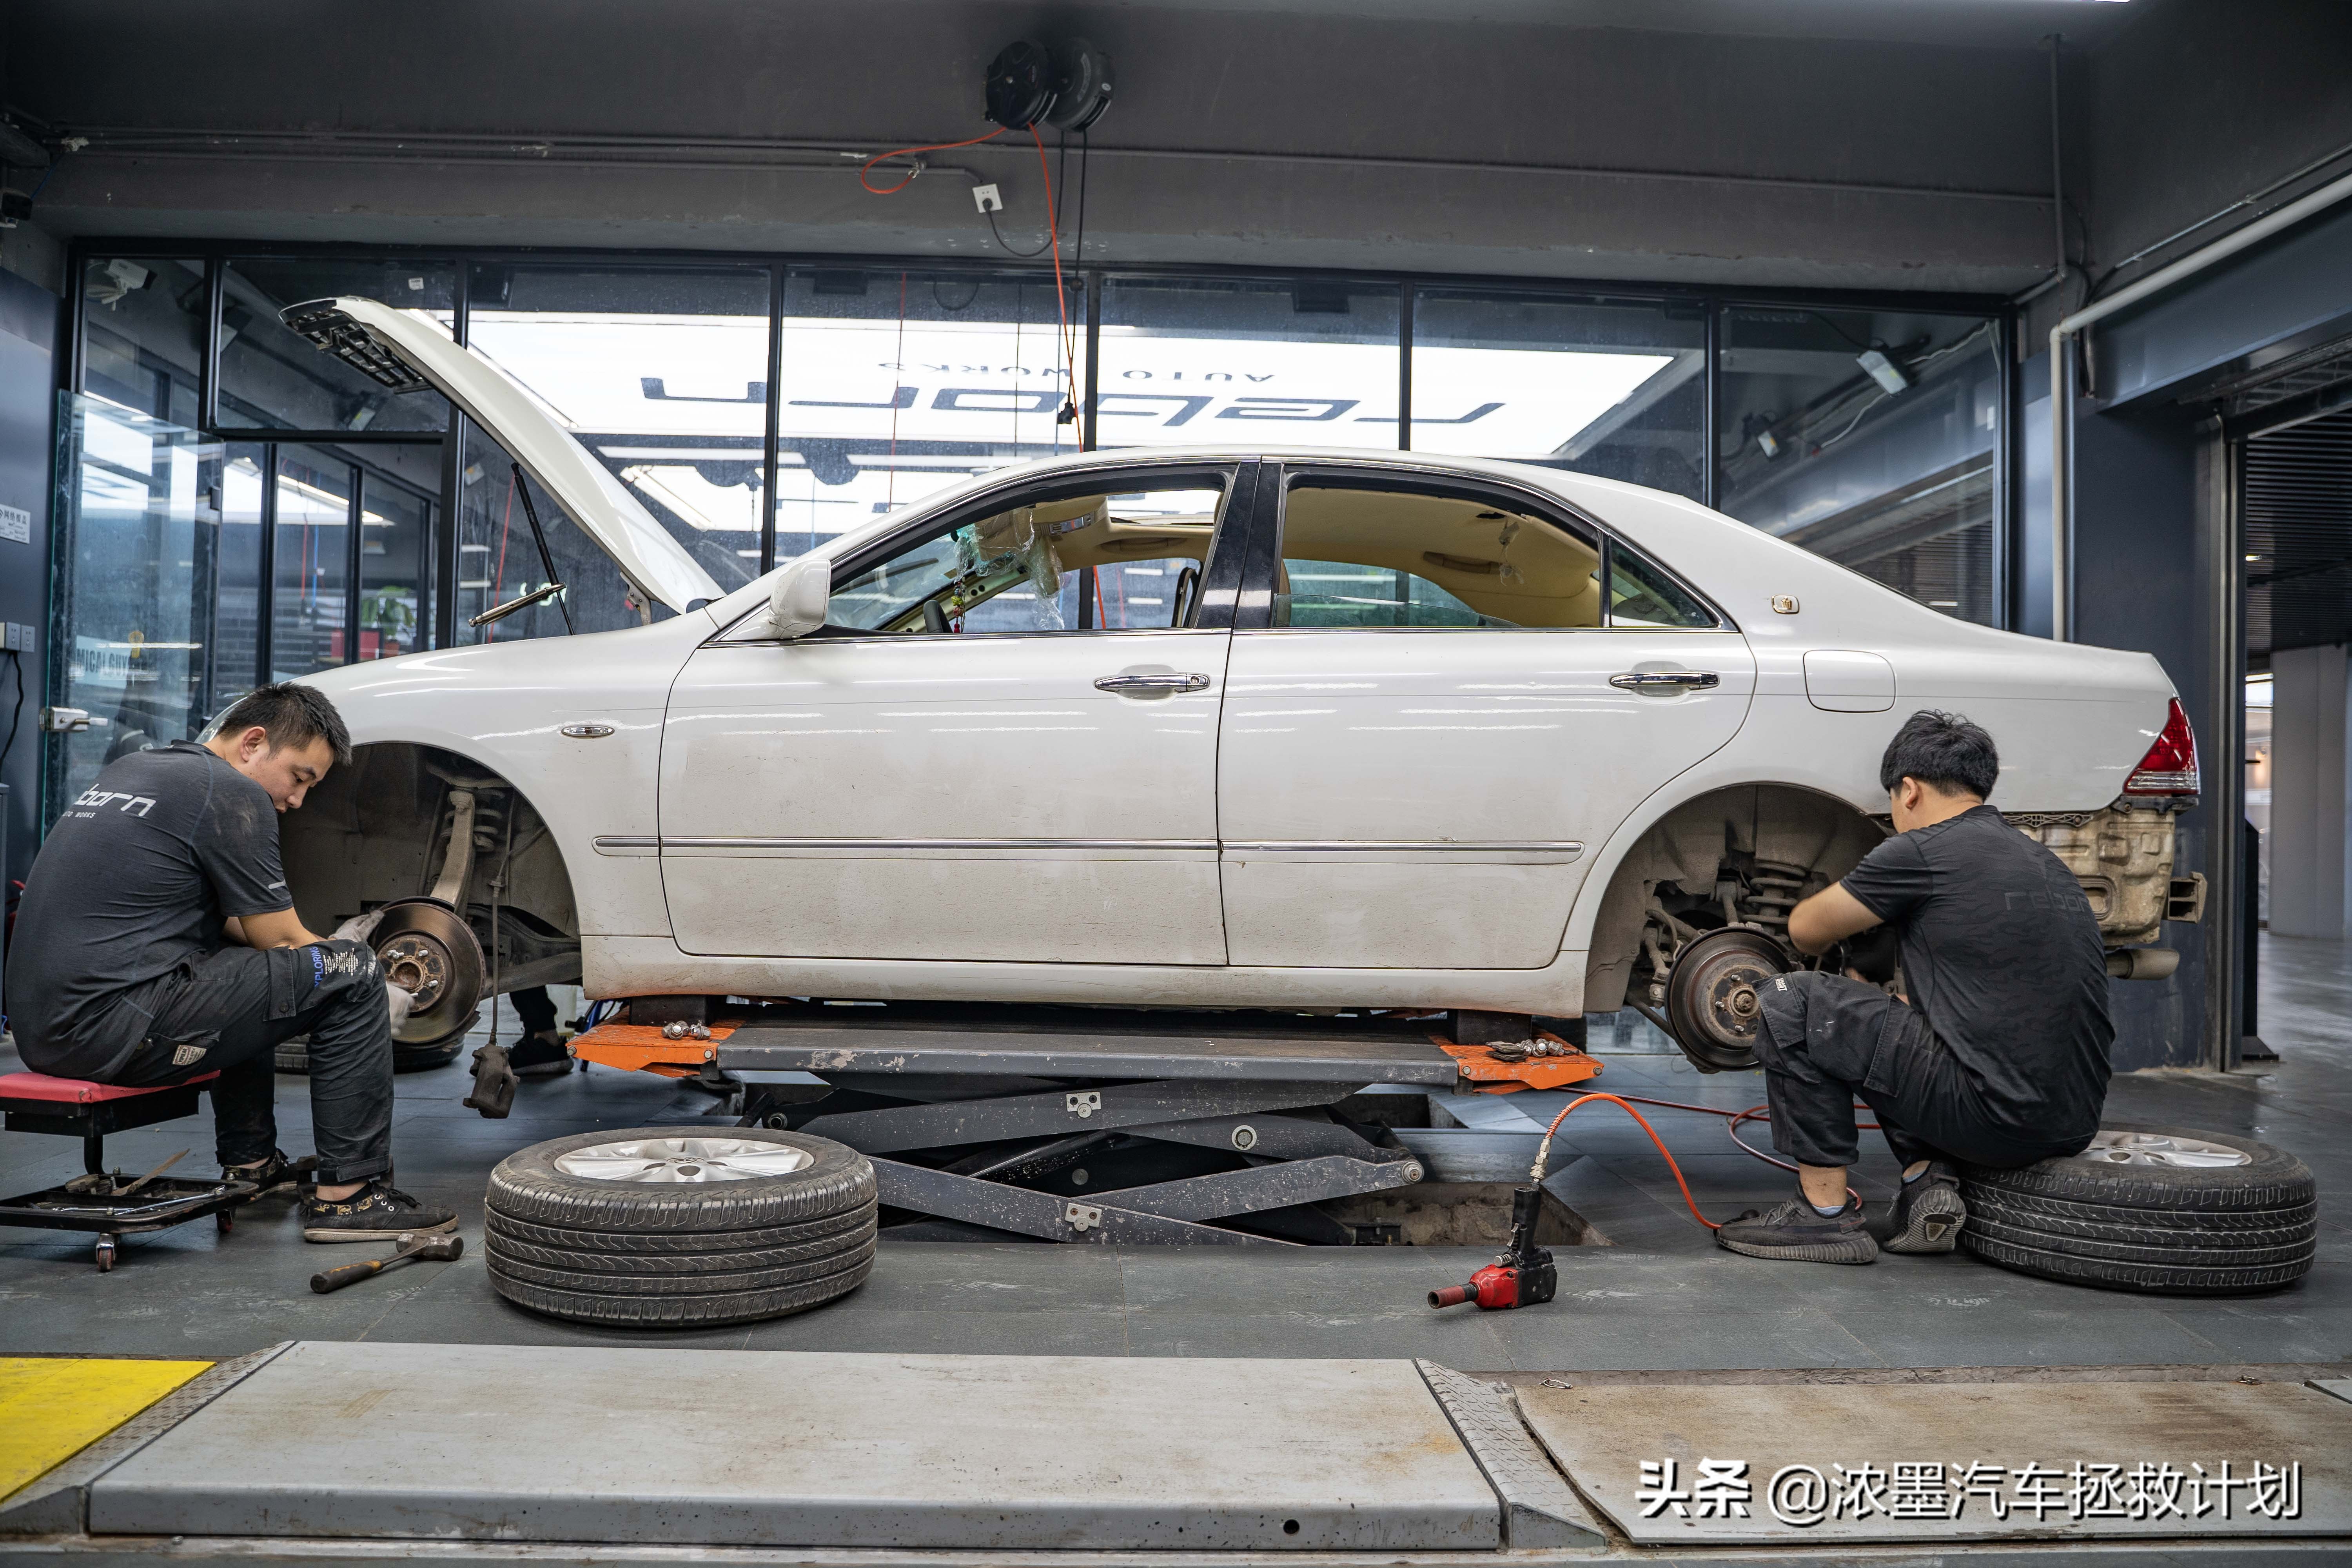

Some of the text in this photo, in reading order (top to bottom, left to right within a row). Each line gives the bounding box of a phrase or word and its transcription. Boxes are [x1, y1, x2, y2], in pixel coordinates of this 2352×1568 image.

[878, 362, 1274, 383] AUTO WORKS
[641, 377, 1505, 426] reborn
[109, 653, 128, 677] GUY
[73, 784, 156, 817] born
[2004, 884, 2090, 913] rebor
